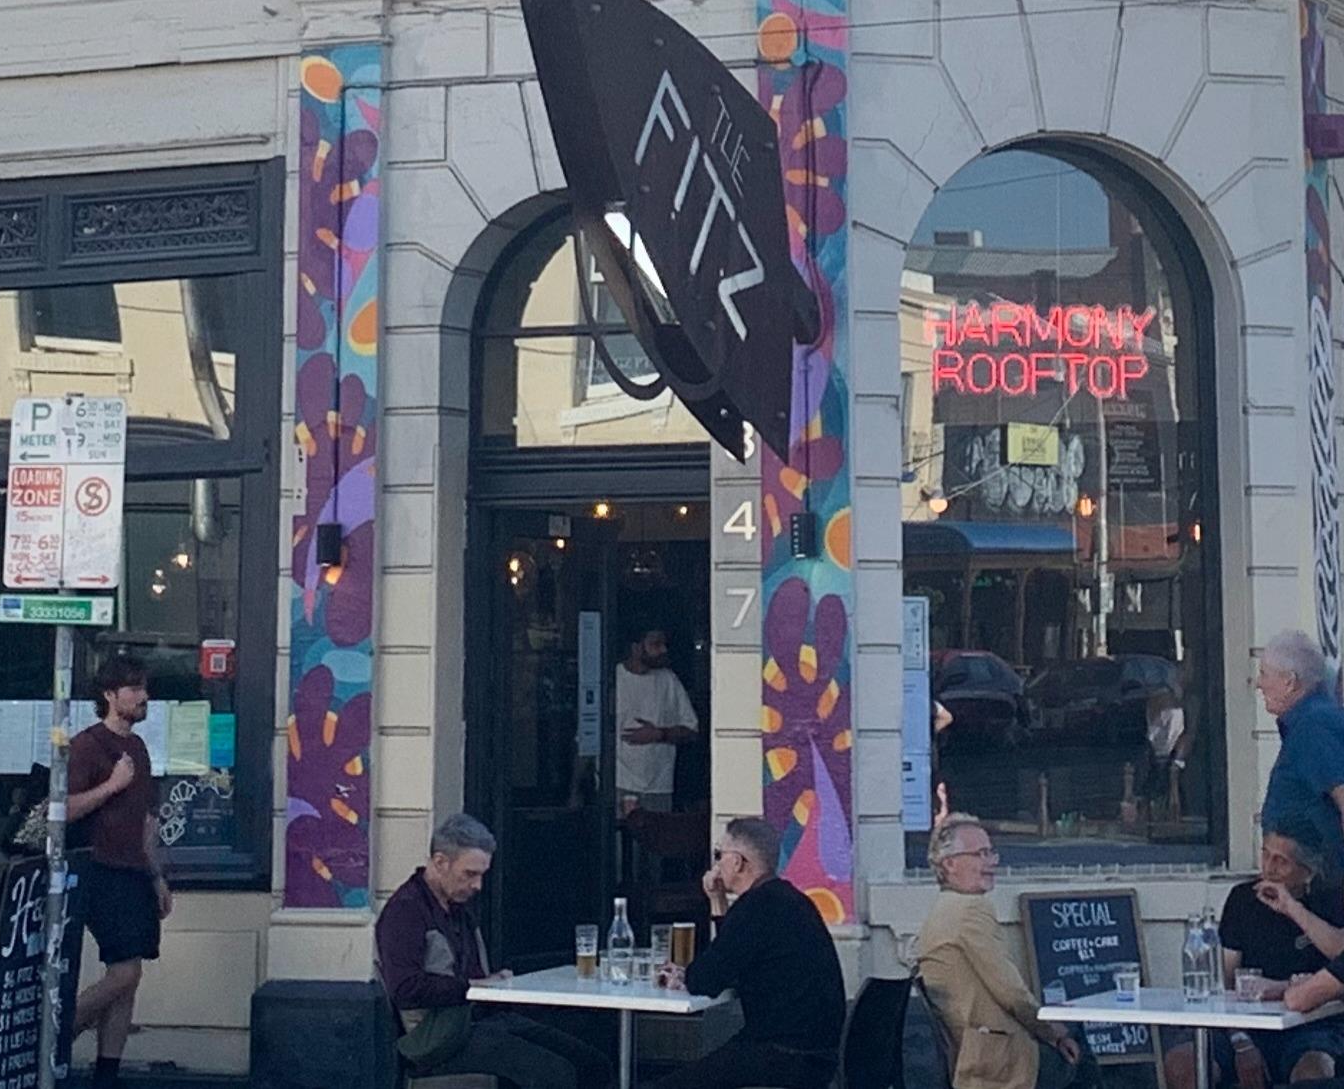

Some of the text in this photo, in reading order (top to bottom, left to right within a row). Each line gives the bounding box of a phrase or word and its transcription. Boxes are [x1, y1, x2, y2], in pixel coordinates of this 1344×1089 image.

[634, 69, 765, 343] FITZ
[923, 300, 1157, 350] HARMONY
[932, 350, 1150, 398] ROOFTOP
[31, 402, 52, 431] P
[20, 434, 56, 447] METER
[14, 468, 62, 487] LOADING
[11, 489, 61, 506] ZONE
[1051, 900, 1118, 929] SPECIAL
[1121, 1025, 1149, 1046] $10
